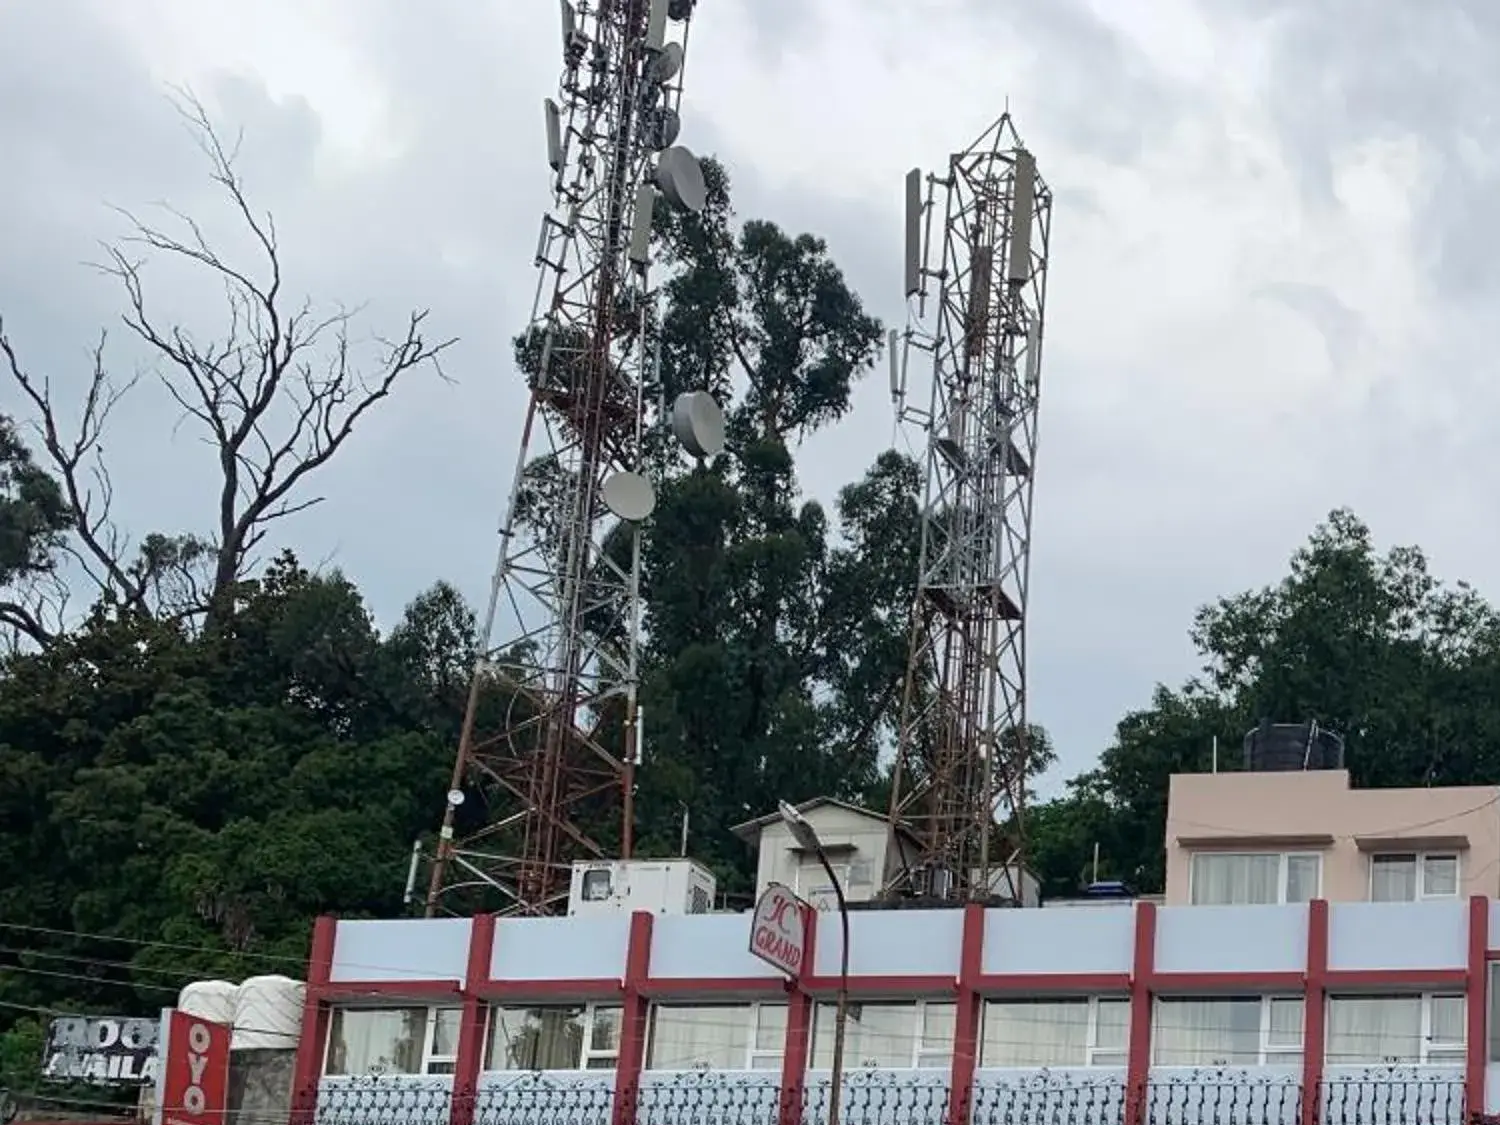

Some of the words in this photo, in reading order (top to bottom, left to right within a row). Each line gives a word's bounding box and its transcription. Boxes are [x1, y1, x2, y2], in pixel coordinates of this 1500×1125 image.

[762, 894, 798, 934] JC
[756, 926, 800, 966] GRAND
[183, 1024, 211, 1115] OYO
